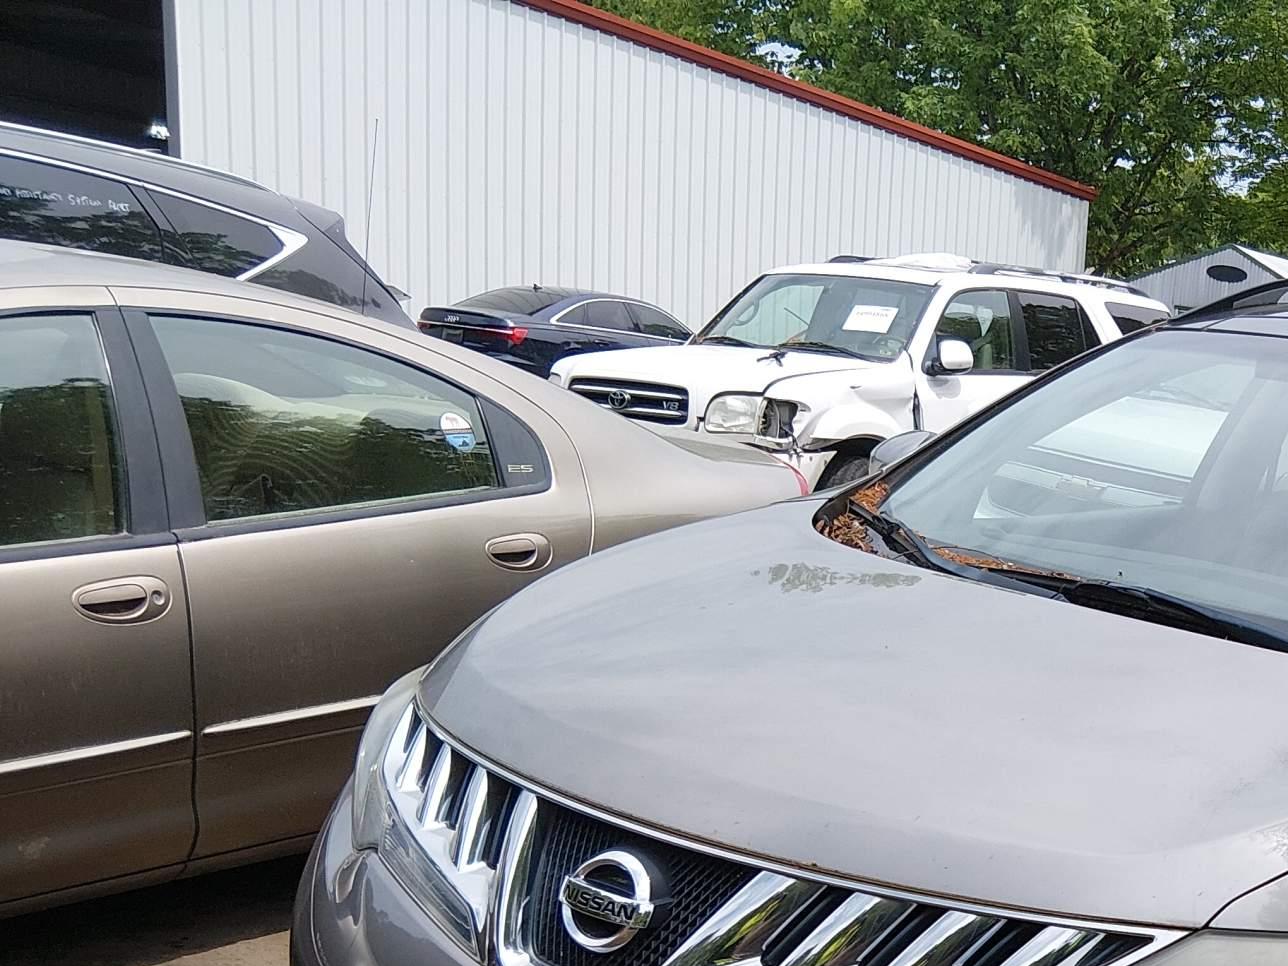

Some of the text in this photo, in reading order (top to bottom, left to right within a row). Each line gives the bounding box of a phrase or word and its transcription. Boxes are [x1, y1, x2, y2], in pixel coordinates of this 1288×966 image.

[662, 400, 680, 411] V8
[507, 464, 535, 473] ES
[564, 883, 637, 921] NISSAN
